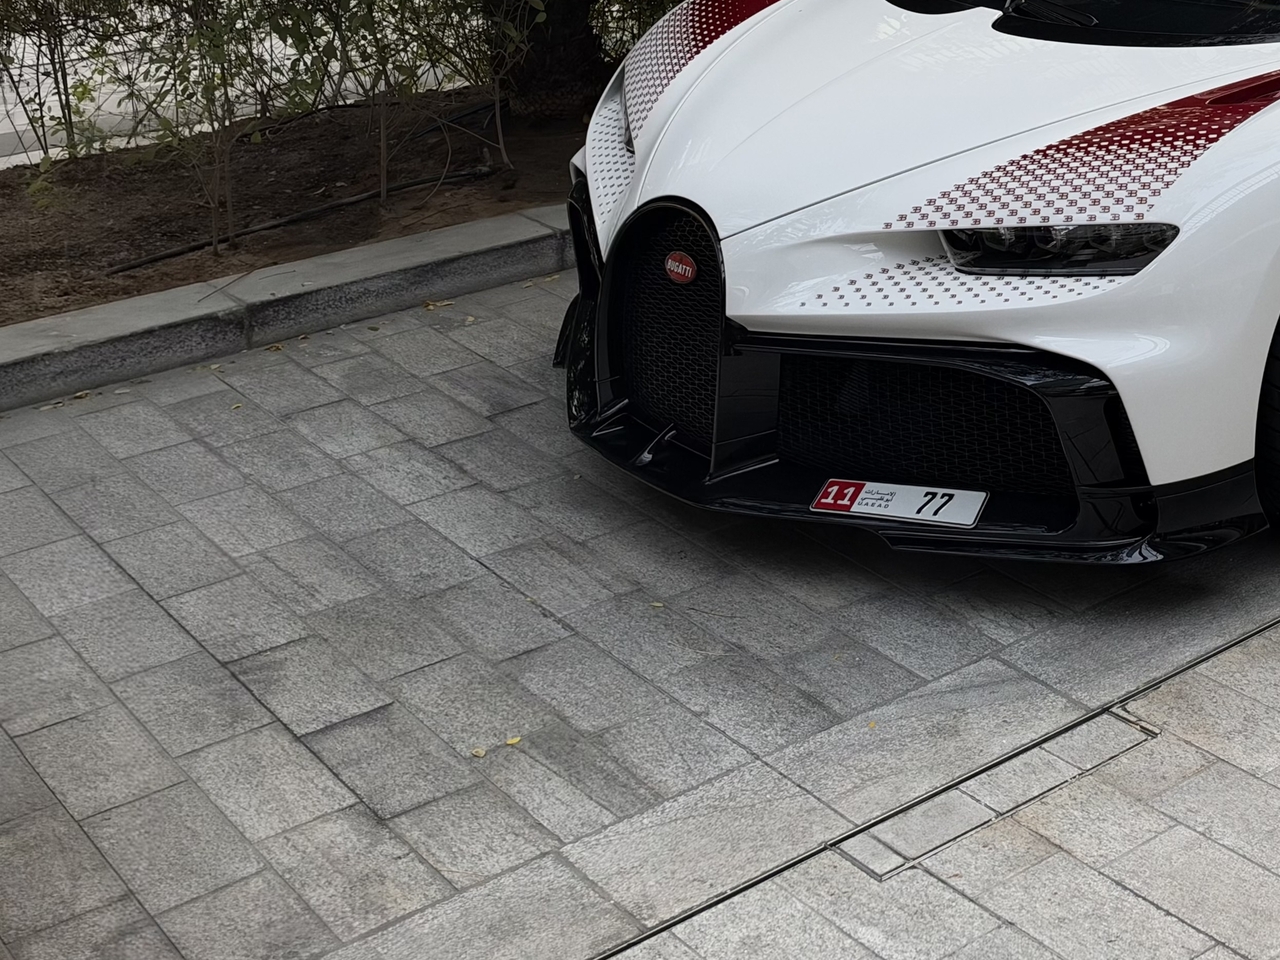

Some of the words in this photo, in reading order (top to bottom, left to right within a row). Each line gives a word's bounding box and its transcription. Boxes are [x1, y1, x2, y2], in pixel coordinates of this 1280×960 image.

[667, 258, 693, 278] BUGATTI
[820, 485, 856, 506] 11
[915, 491, 955, 517] 77
